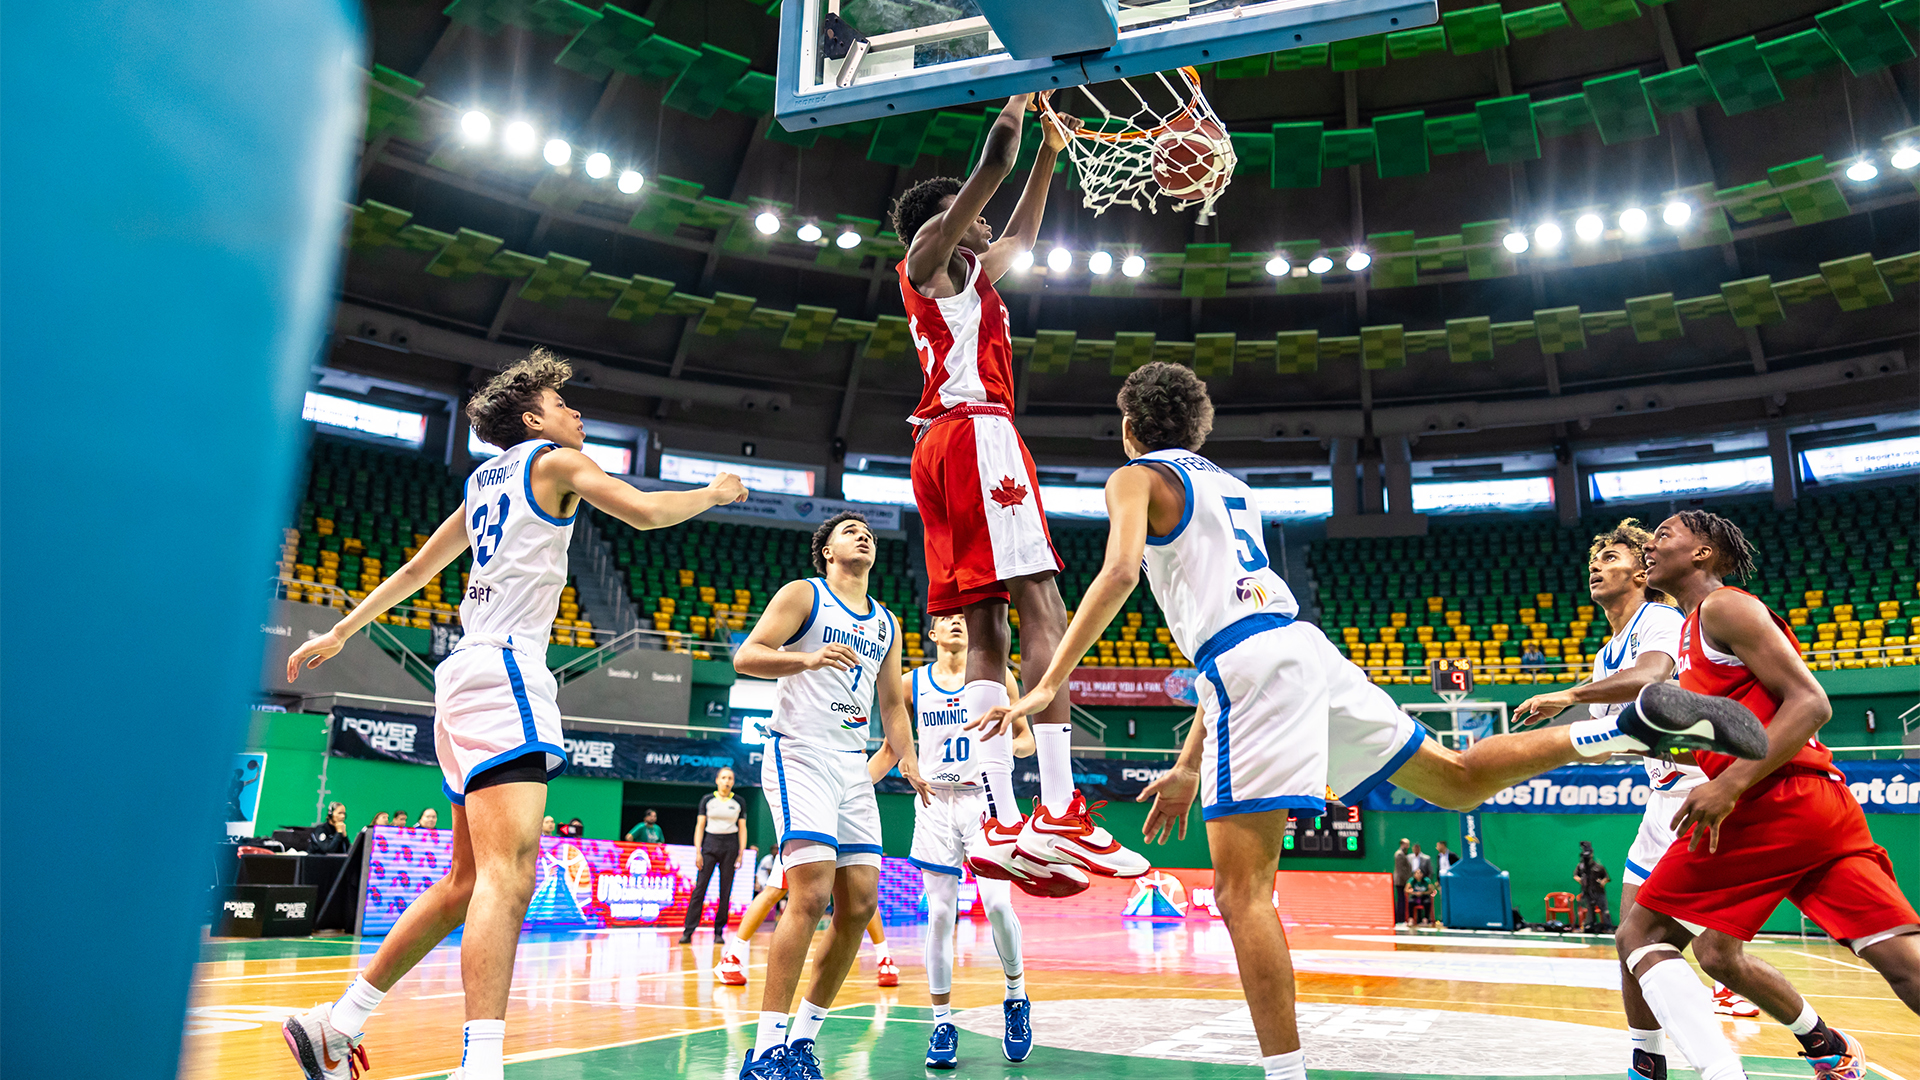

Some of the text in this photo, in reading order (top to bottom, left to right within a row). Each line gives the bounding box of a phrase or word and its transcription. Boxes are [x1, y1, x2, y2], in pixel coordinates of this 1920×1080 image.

[472, 493, 511, 568] 23
[1221, 495, 1269, 573] 5
[850, 664, 863, 692] 7
[1136, 682, 1143, 692] A
[1451, 672, 1465, 691] 9
[342, 717, 418, 741] POWER
[371, 736, 415, 753] ADE
[942, 736, 970, 763] 10
[572, 753, 614, 768] ADE
[1347, 806, 1360, 823] 3
[223, 901, 256, 911] POWER
[275, 902, 308, 913] POWER
